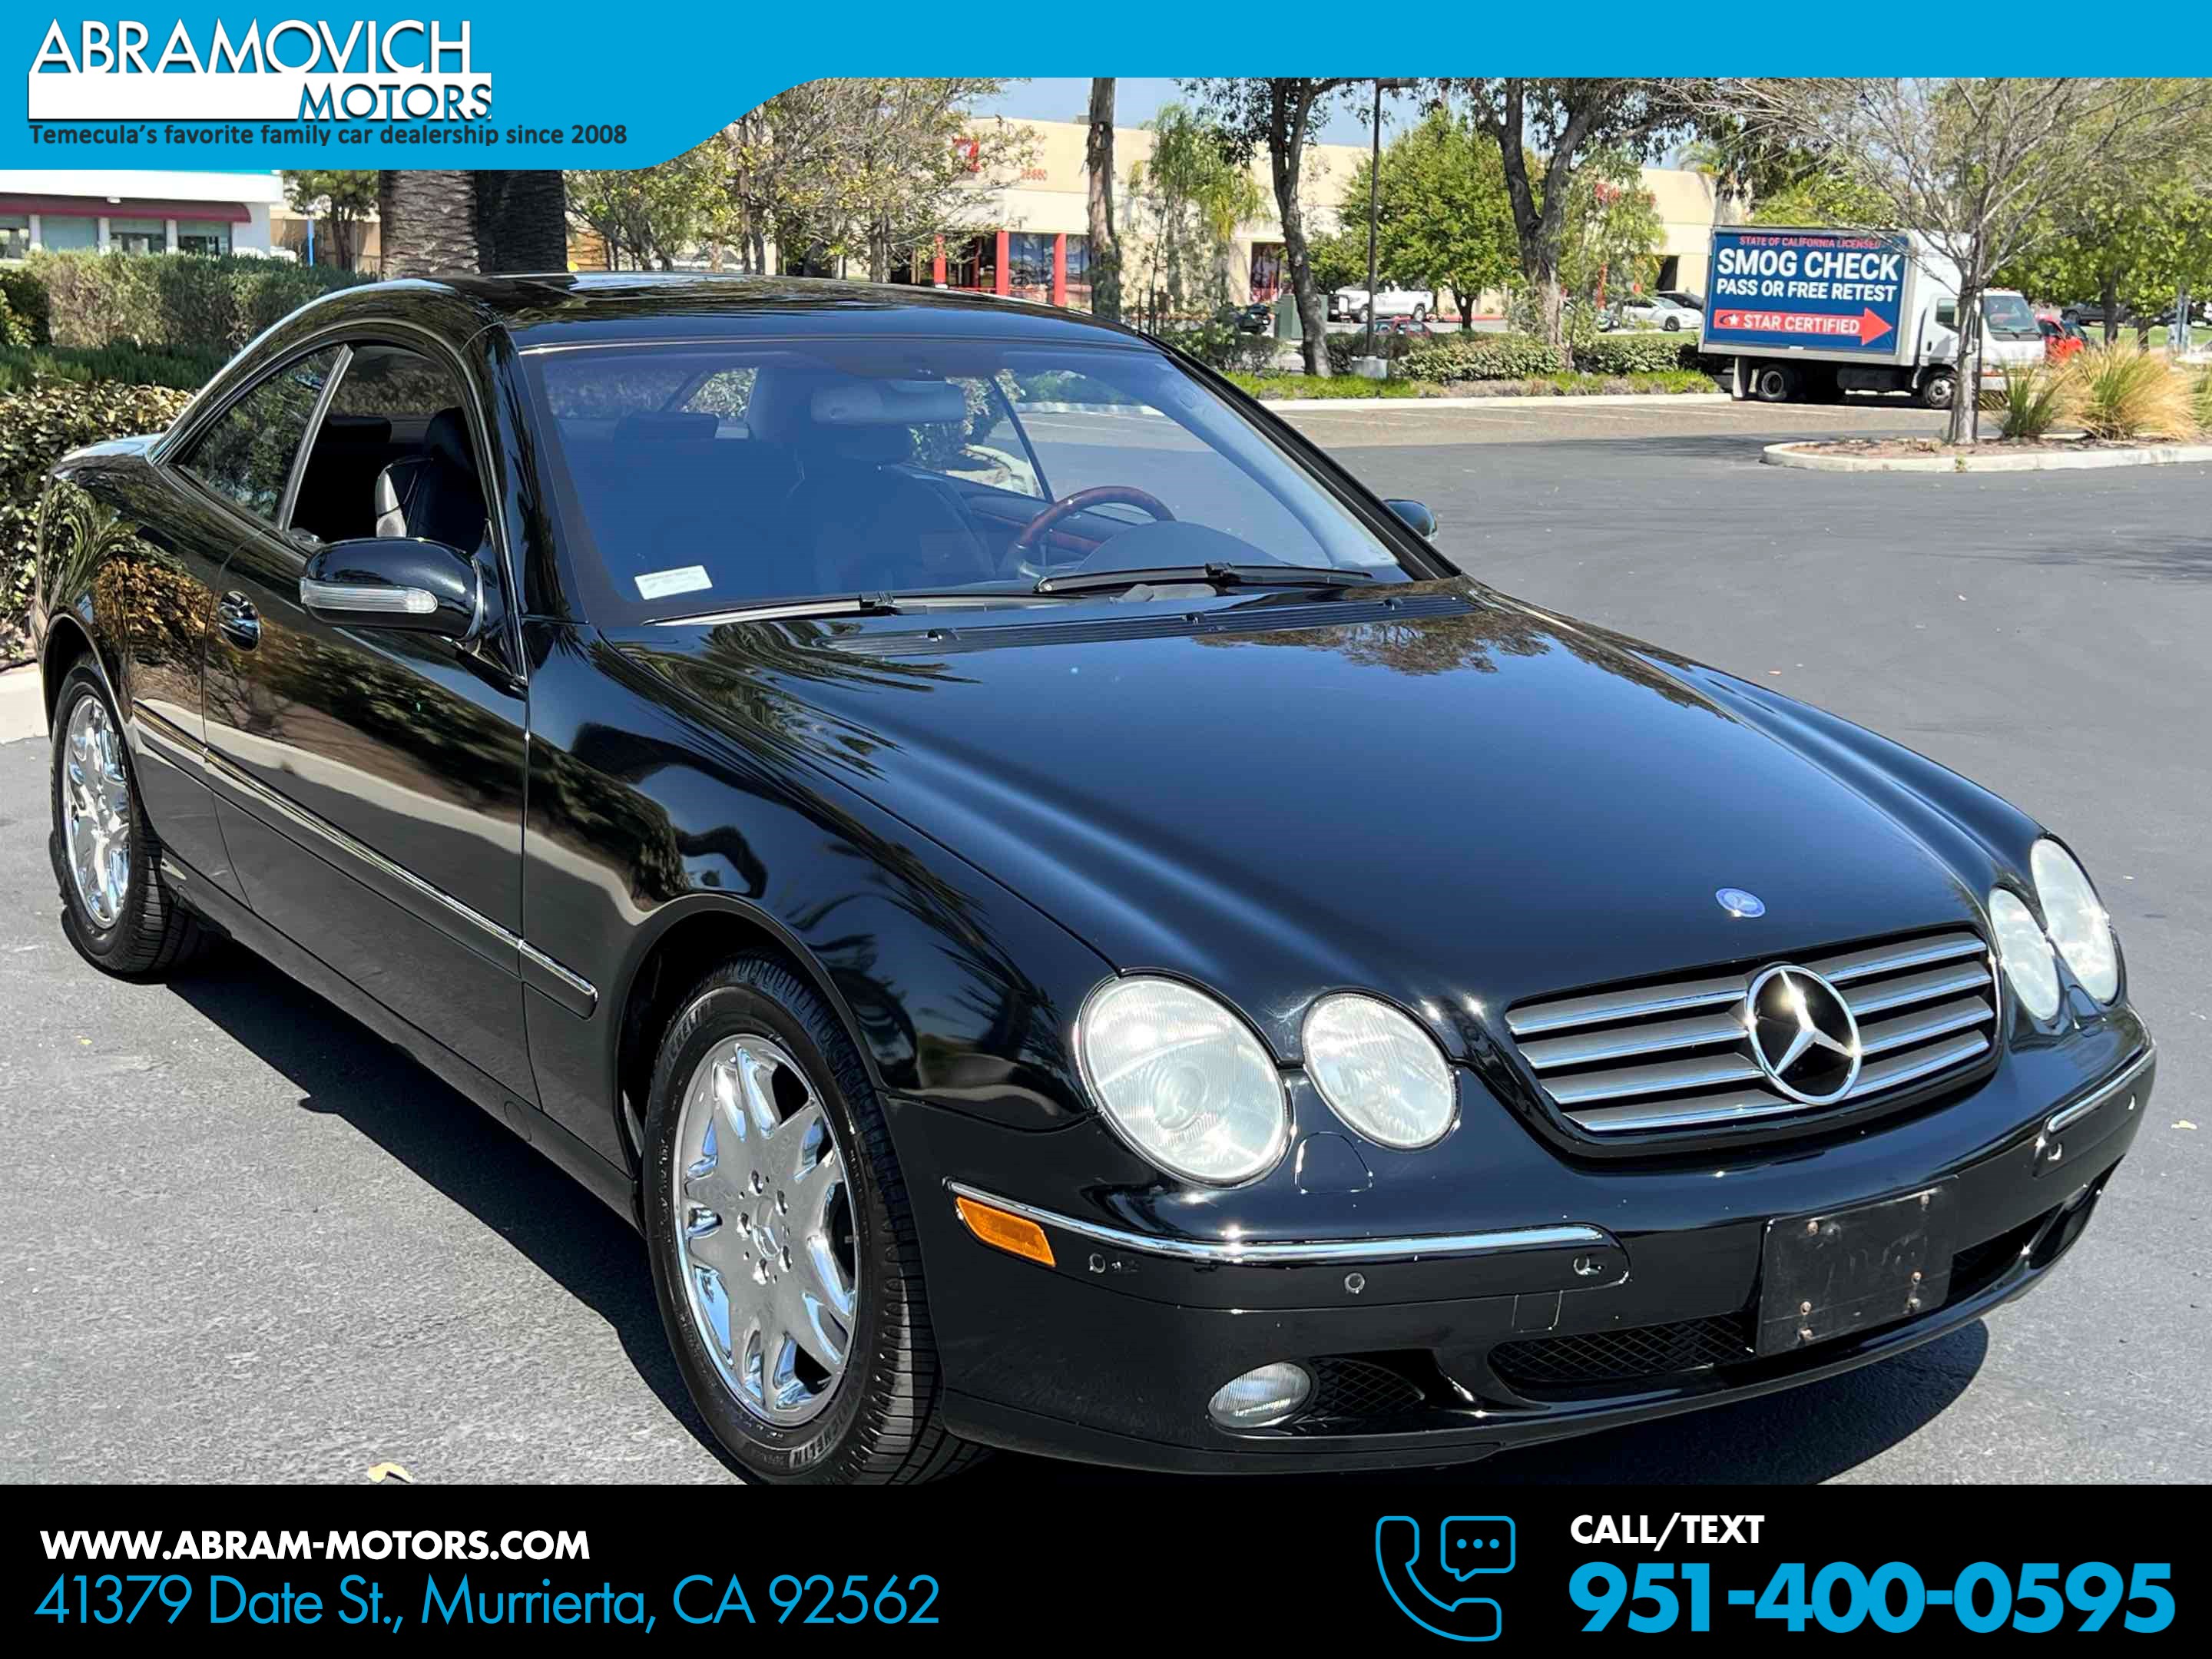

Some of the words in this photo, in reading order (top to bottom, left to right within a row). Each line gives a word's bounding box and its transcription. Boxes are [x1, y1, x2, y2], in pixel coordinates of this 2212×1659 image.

[1740, 235, 1767, 247] STATE
[1769, 237, 1779, 247] OF
[1781, 237, 1835, 248] CALIFORNIA
[1836, 238, 1881, 250] LICENSED
[1717, 247, 1798, 278] SMOG
[1805, 250, 1901, 281] CHECK
[1716, 278, 1758, 296] PASS
[1761, 280, 1784, 298] OR
[1787, 281, 1827, 300] FREE
[1831, 283, 1898, 303] RETEST
[1743, 313, 1782, 329] STAR
[1784, 316, 1860, 334] CERTIFIED
